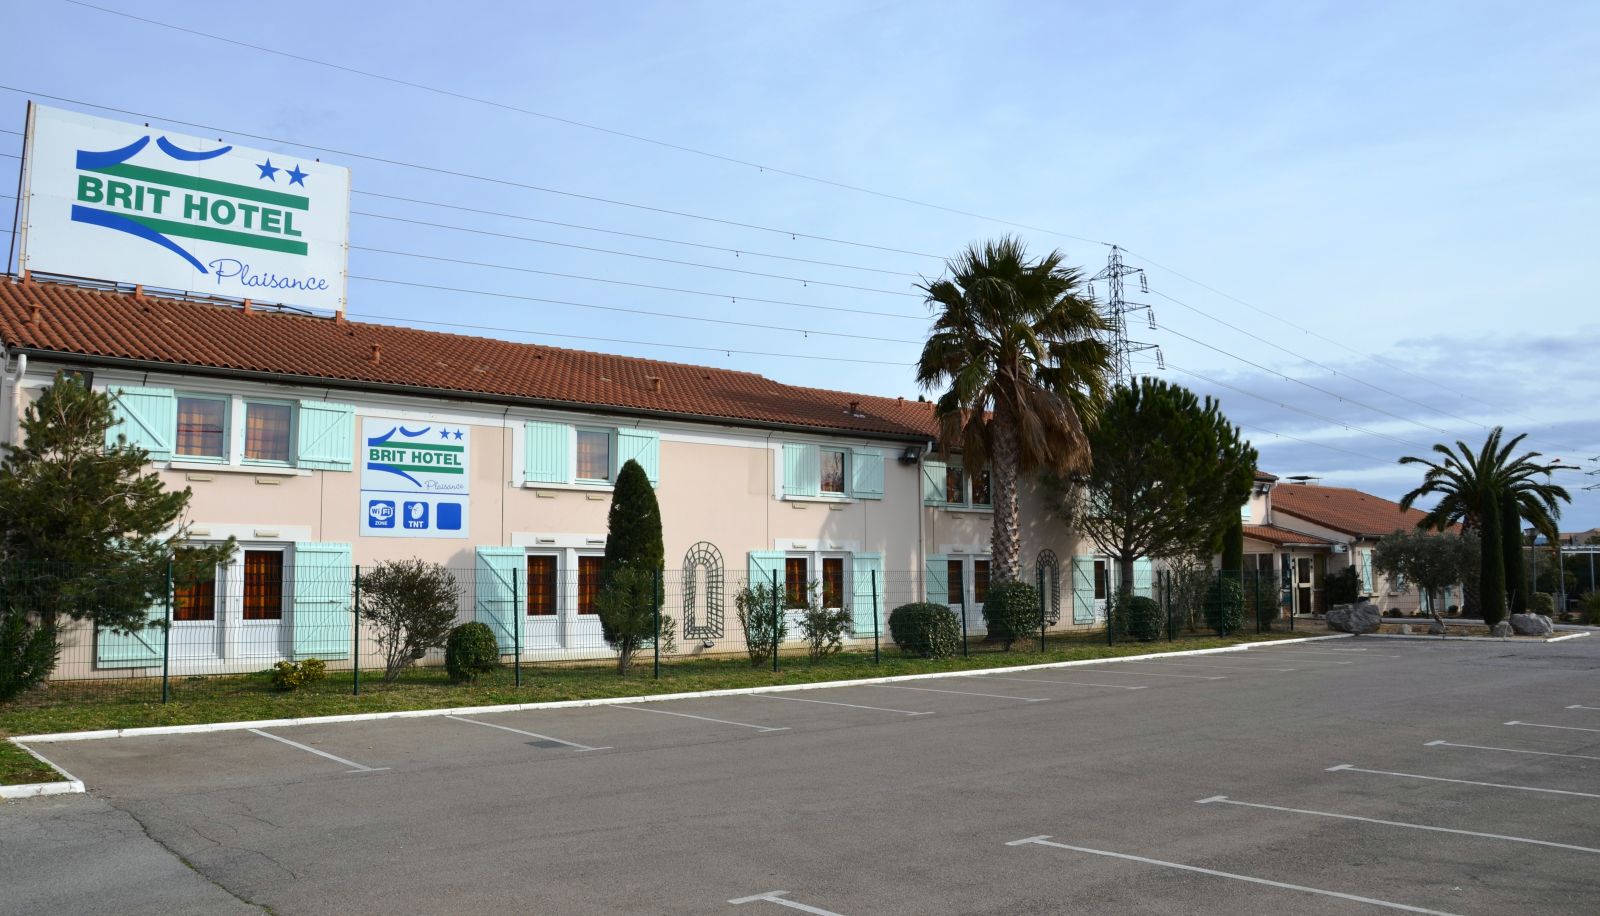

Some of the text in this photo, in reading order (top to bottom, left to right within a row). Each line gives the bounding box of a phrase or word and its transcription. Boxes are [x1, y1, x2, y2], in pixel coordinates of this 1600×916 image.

[77, 174, 302, 237] BRIT HOTEL
[208, 258, 329, 291] Plaisance
[369, 449, 461, 465] BRIT HOTEL
[424, 480, 464, 490] Plaisance
[408, 520, 424, 528] TNT
